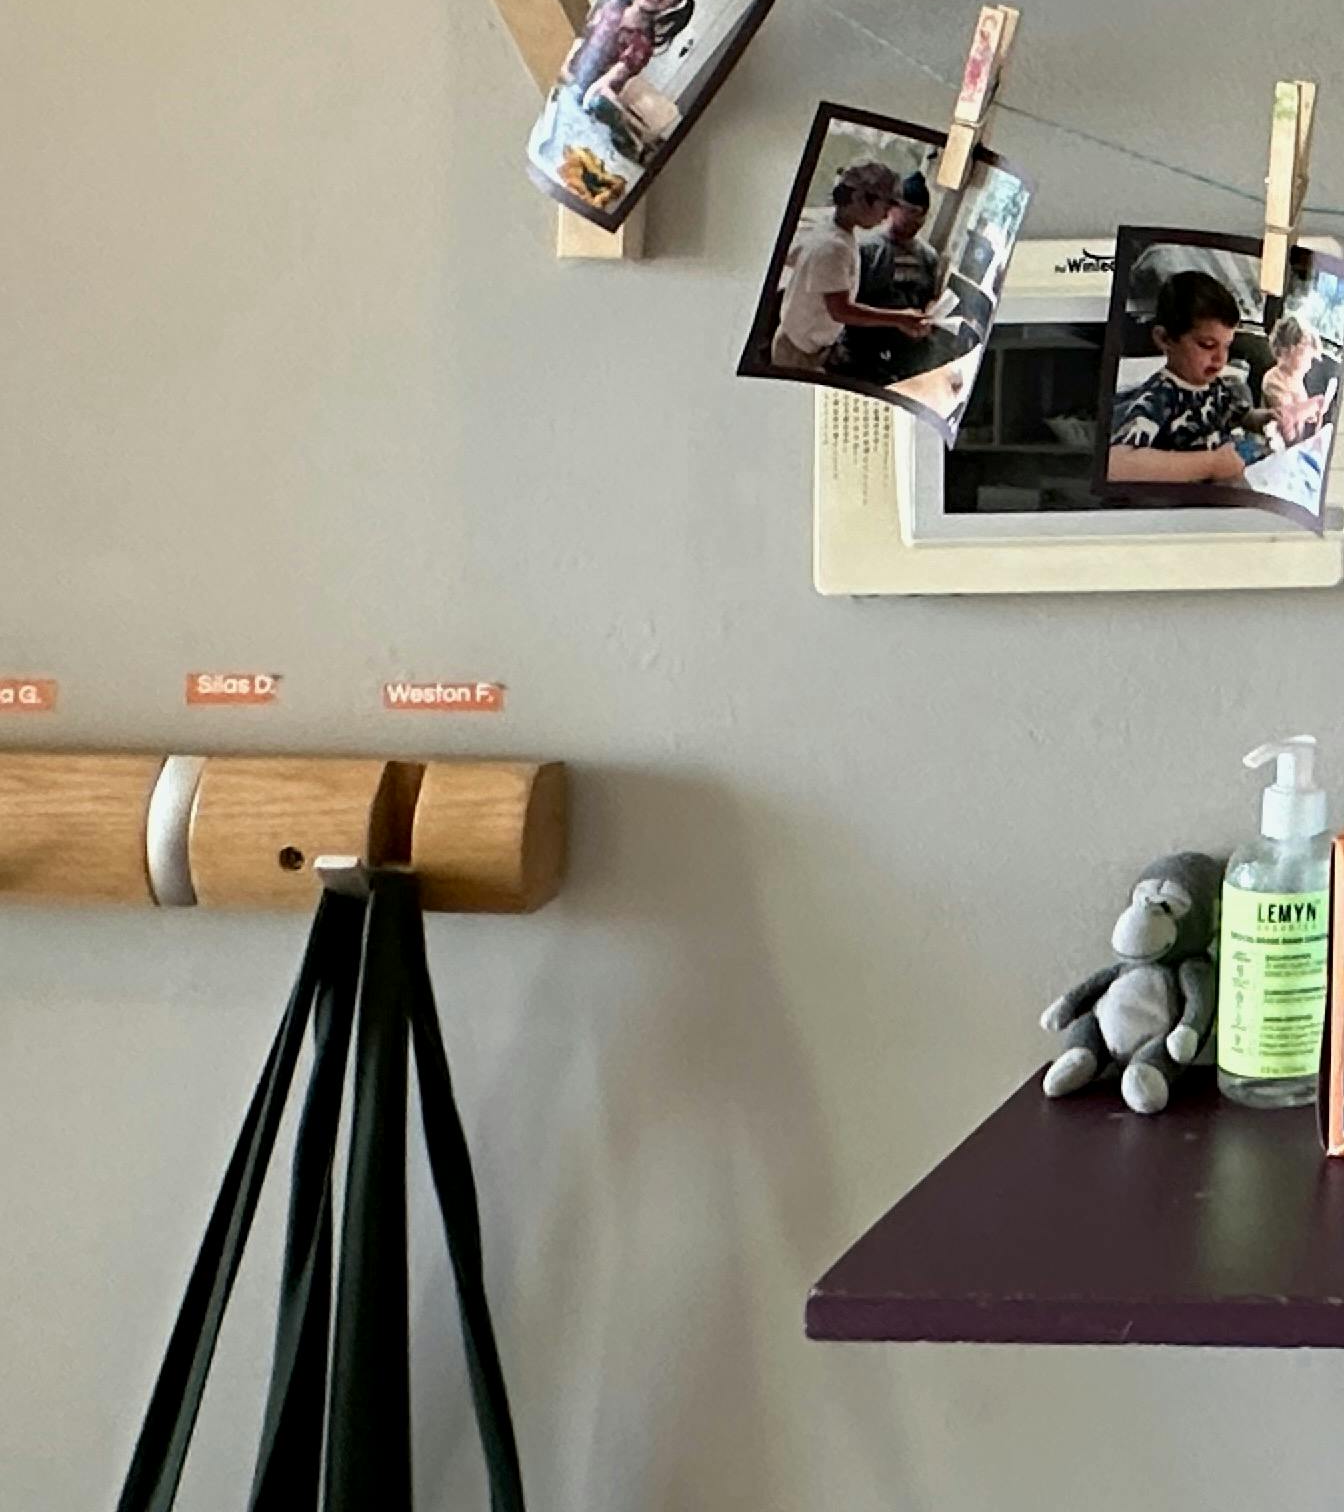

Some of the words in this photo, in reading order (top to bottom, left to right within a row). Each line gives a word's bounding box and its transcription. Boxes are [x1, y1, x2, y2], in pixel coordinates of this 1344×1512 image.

[197, 673, 250, 695] Silas
[254, 674, 277, 695] D.
[385, 682, 471, 705] Weston
[474, 684, 495, 704] F.
[1256, 902, 1317, 925] LEMYN
